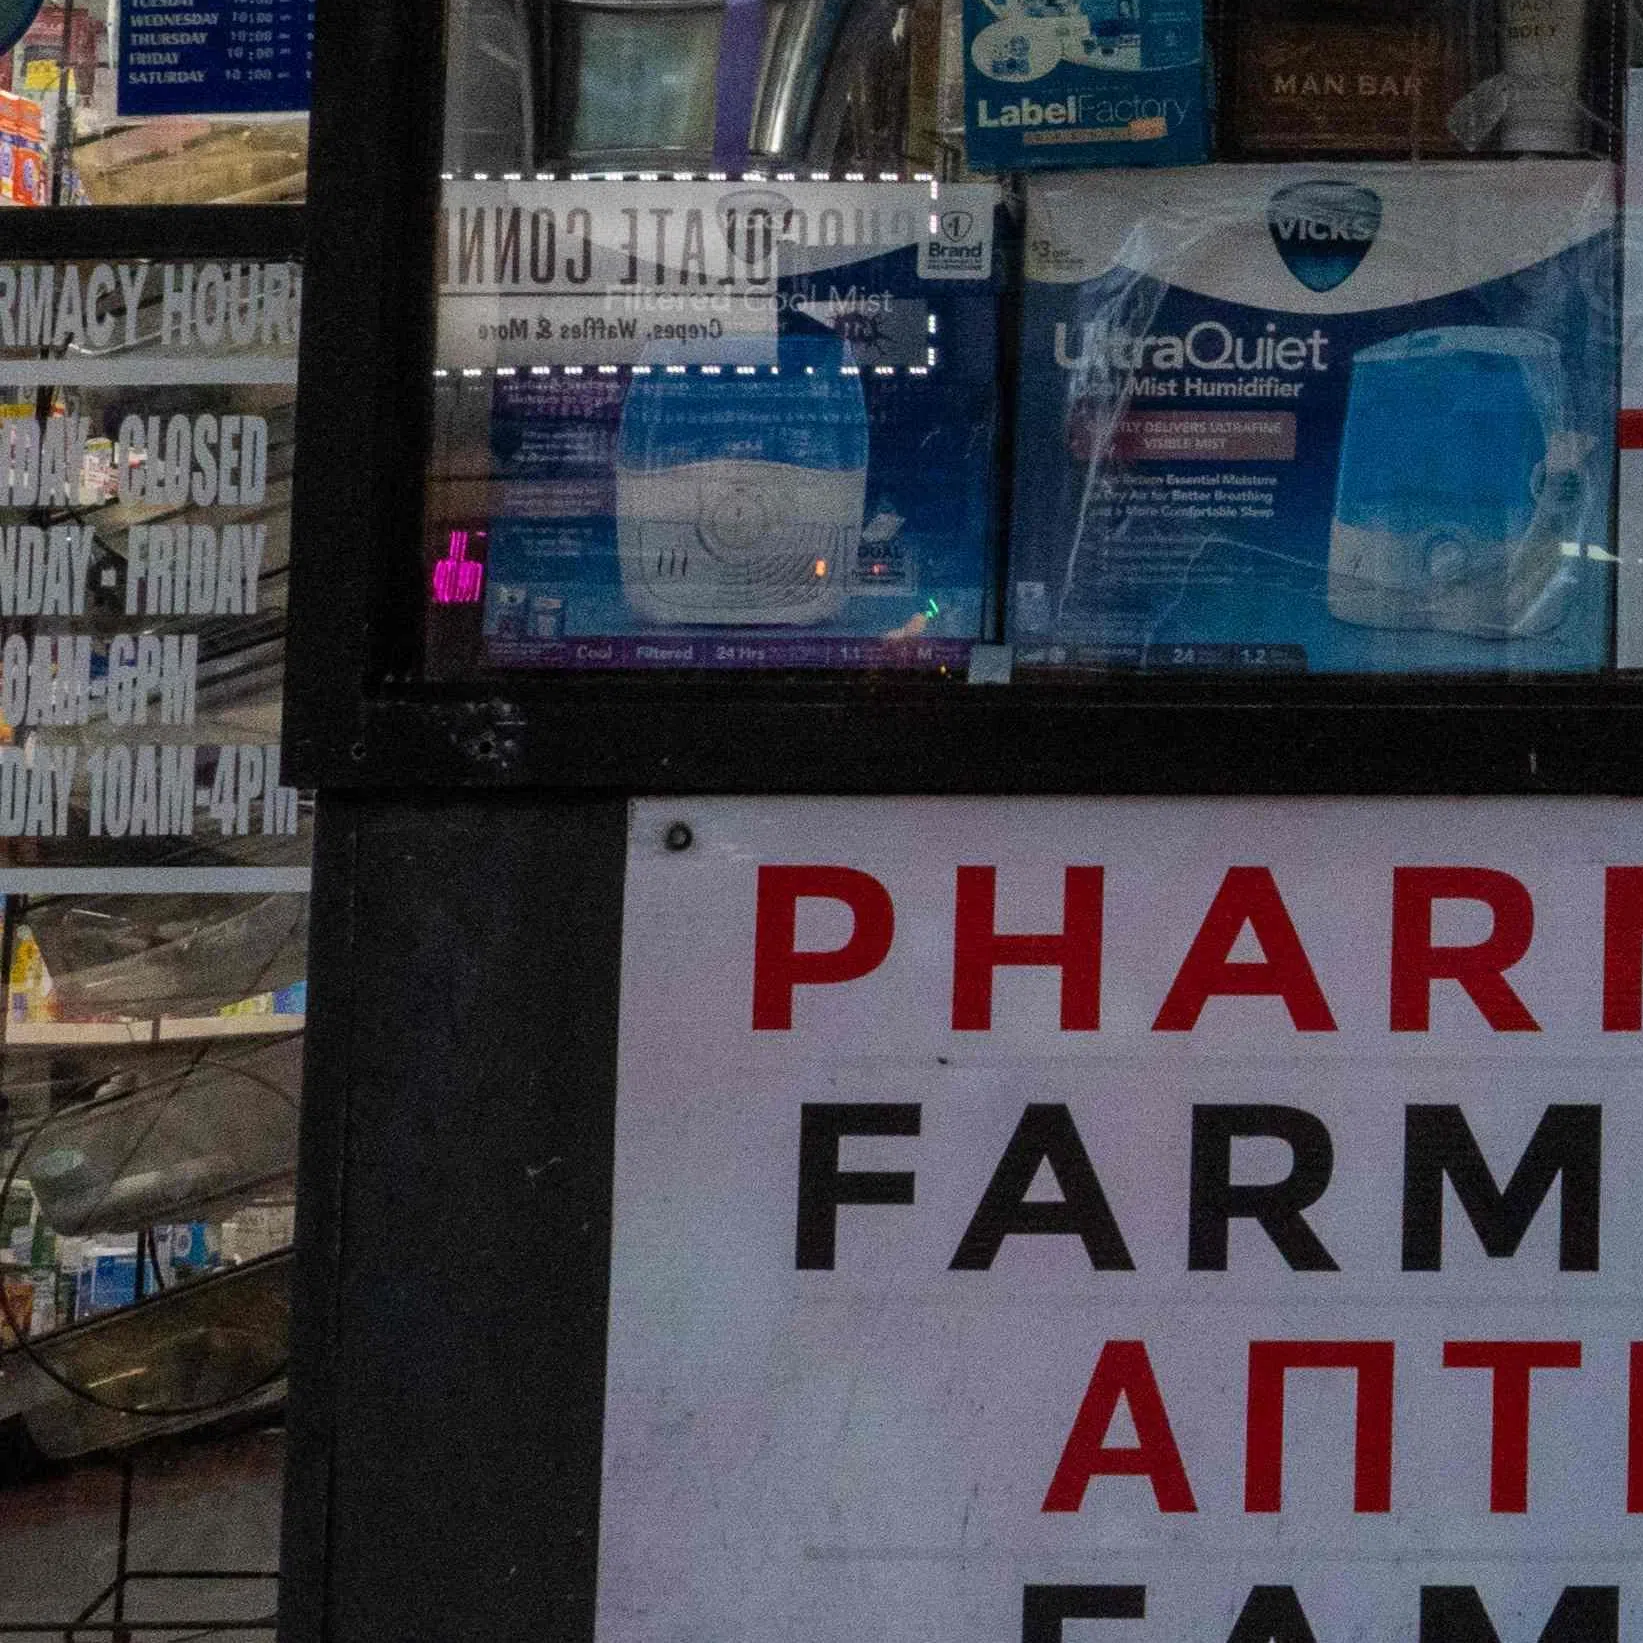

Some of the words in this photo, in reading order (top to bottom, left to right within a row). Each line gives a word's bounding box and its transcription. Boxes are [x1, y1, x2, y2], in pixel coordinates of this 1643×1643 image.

[130, 12, 219, 27] WEDNESDAY
[130, 33, 208, 45] THURSDAY
[129, 52, 181, 65] FRIDAY
[129, 70, 206, 84] SATURDAY
[1273, 75, 1345, 96] MAN
[1357, 75, 1423, 96] BAR
[978, 93, 1190, 128] LabelFactory
[1276, 218, 1372, 242] VICKS
[928, 241, 983, 257] Brand
[603, 285, 730, 314] Filtered
[743, 284, 816, 314] Cool
[826, 286, 893, 314] Mist
[1053, 320, 1328, 372] UltraQuiet
[1130, 376, 1179, 398] Mist
[1184, 376, 1304, 399] Humidifier
[1144, 422, 1207, 434] DELIVERS
[1210, 422, 1283, 434] ULTRAFINE
[1143, 438, 1190, 450] VISIBLE
[1194, 438, 1228, 450] MIST
[117, 415, 268, 506] CLOSED
[1165, 474, 1220, 486] Essential
[1172, 490, 1212, 502] Better
[1214, 490, 1274, 504] Breathing
[1160, 506, 1238, 518] Comfortable
[125, 524, 266, 615] FRIDAY
[576, 645, 613, 661] Cool
[636, 645, 694, 662] Filtered
